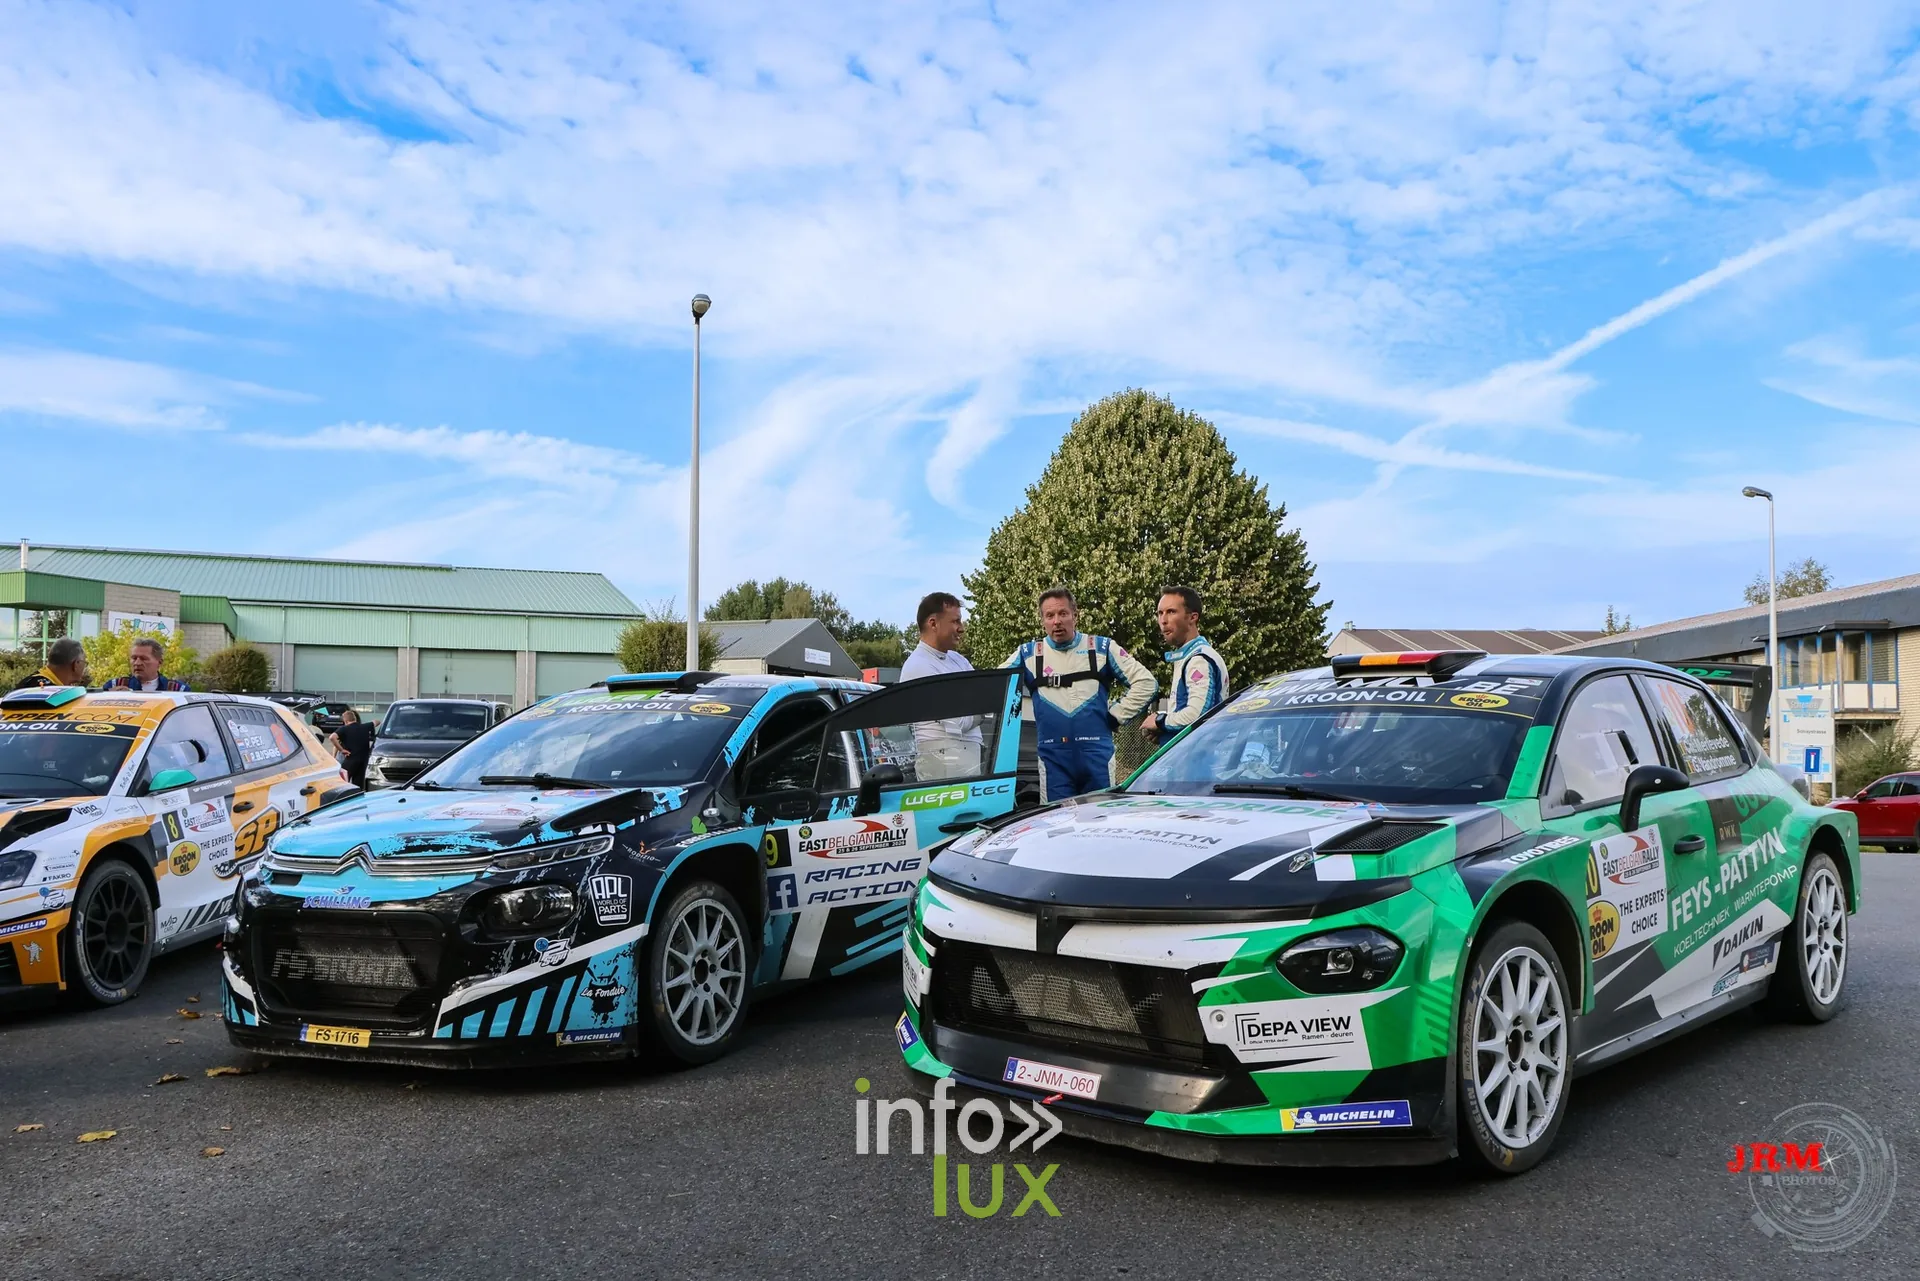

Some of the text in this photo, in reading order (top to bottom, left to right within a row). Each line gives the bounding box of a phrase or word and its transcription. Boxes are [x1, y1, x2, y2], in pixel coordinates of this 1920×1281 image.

[1285, 690, 1428, 705] KROON-OIL
[1458, 696, 1501, 705] KROON
[567, 702, 673, 714] KROON-OIL
[905, 784, 1010, 807] wefa tec
[1096, 800, 1347, 818] GOODRIDE
[167, 813, 179, 839] 8
[235, 808, 278, 859] SP
[1719, 824, 1736, 840] RWK
[200, 840, 210, 850] THE
[765, 833, 779, 866] 9
[859, 842, 890, 851] SEPTEMBER
[173, 851, 197, 866] KROON
[208, 848, 228, 861] CHOICE
[179, 863, 190, 873] OIL
[804, 857, 922, 884] RACING
[48, 873, 71, 881] FAKRO
[591, 876, 628, 900] APL
[303, 895, 371, 909] SCHILLING
[598, 904, 628, 915] PARTS
[1619, 900, 1633, 917] THE
[1673, 906, 1731, 958] KOELTECHNIEK
[1733, 864, 1798, 912] WARMTEPOMP
[1590, 917, 1614, 941] ROON
[1631, 912, 1658, 934] CHOICE
[1723, 914, 1764, 958] DAIKIN
[1592, 937, 1606, 955] OIL
[581, 986, 626, 997] La Fondue
[1247, 1015, 1351, 1038] DEPA VIEW
[315, 1028, 359, 1044] FS-1716
[574, 1031, 621, 1041] MICHELIN
[1006, 1069, 1013, 1080] B
[1318, 1109, 1395, 1122] MICHELIN
